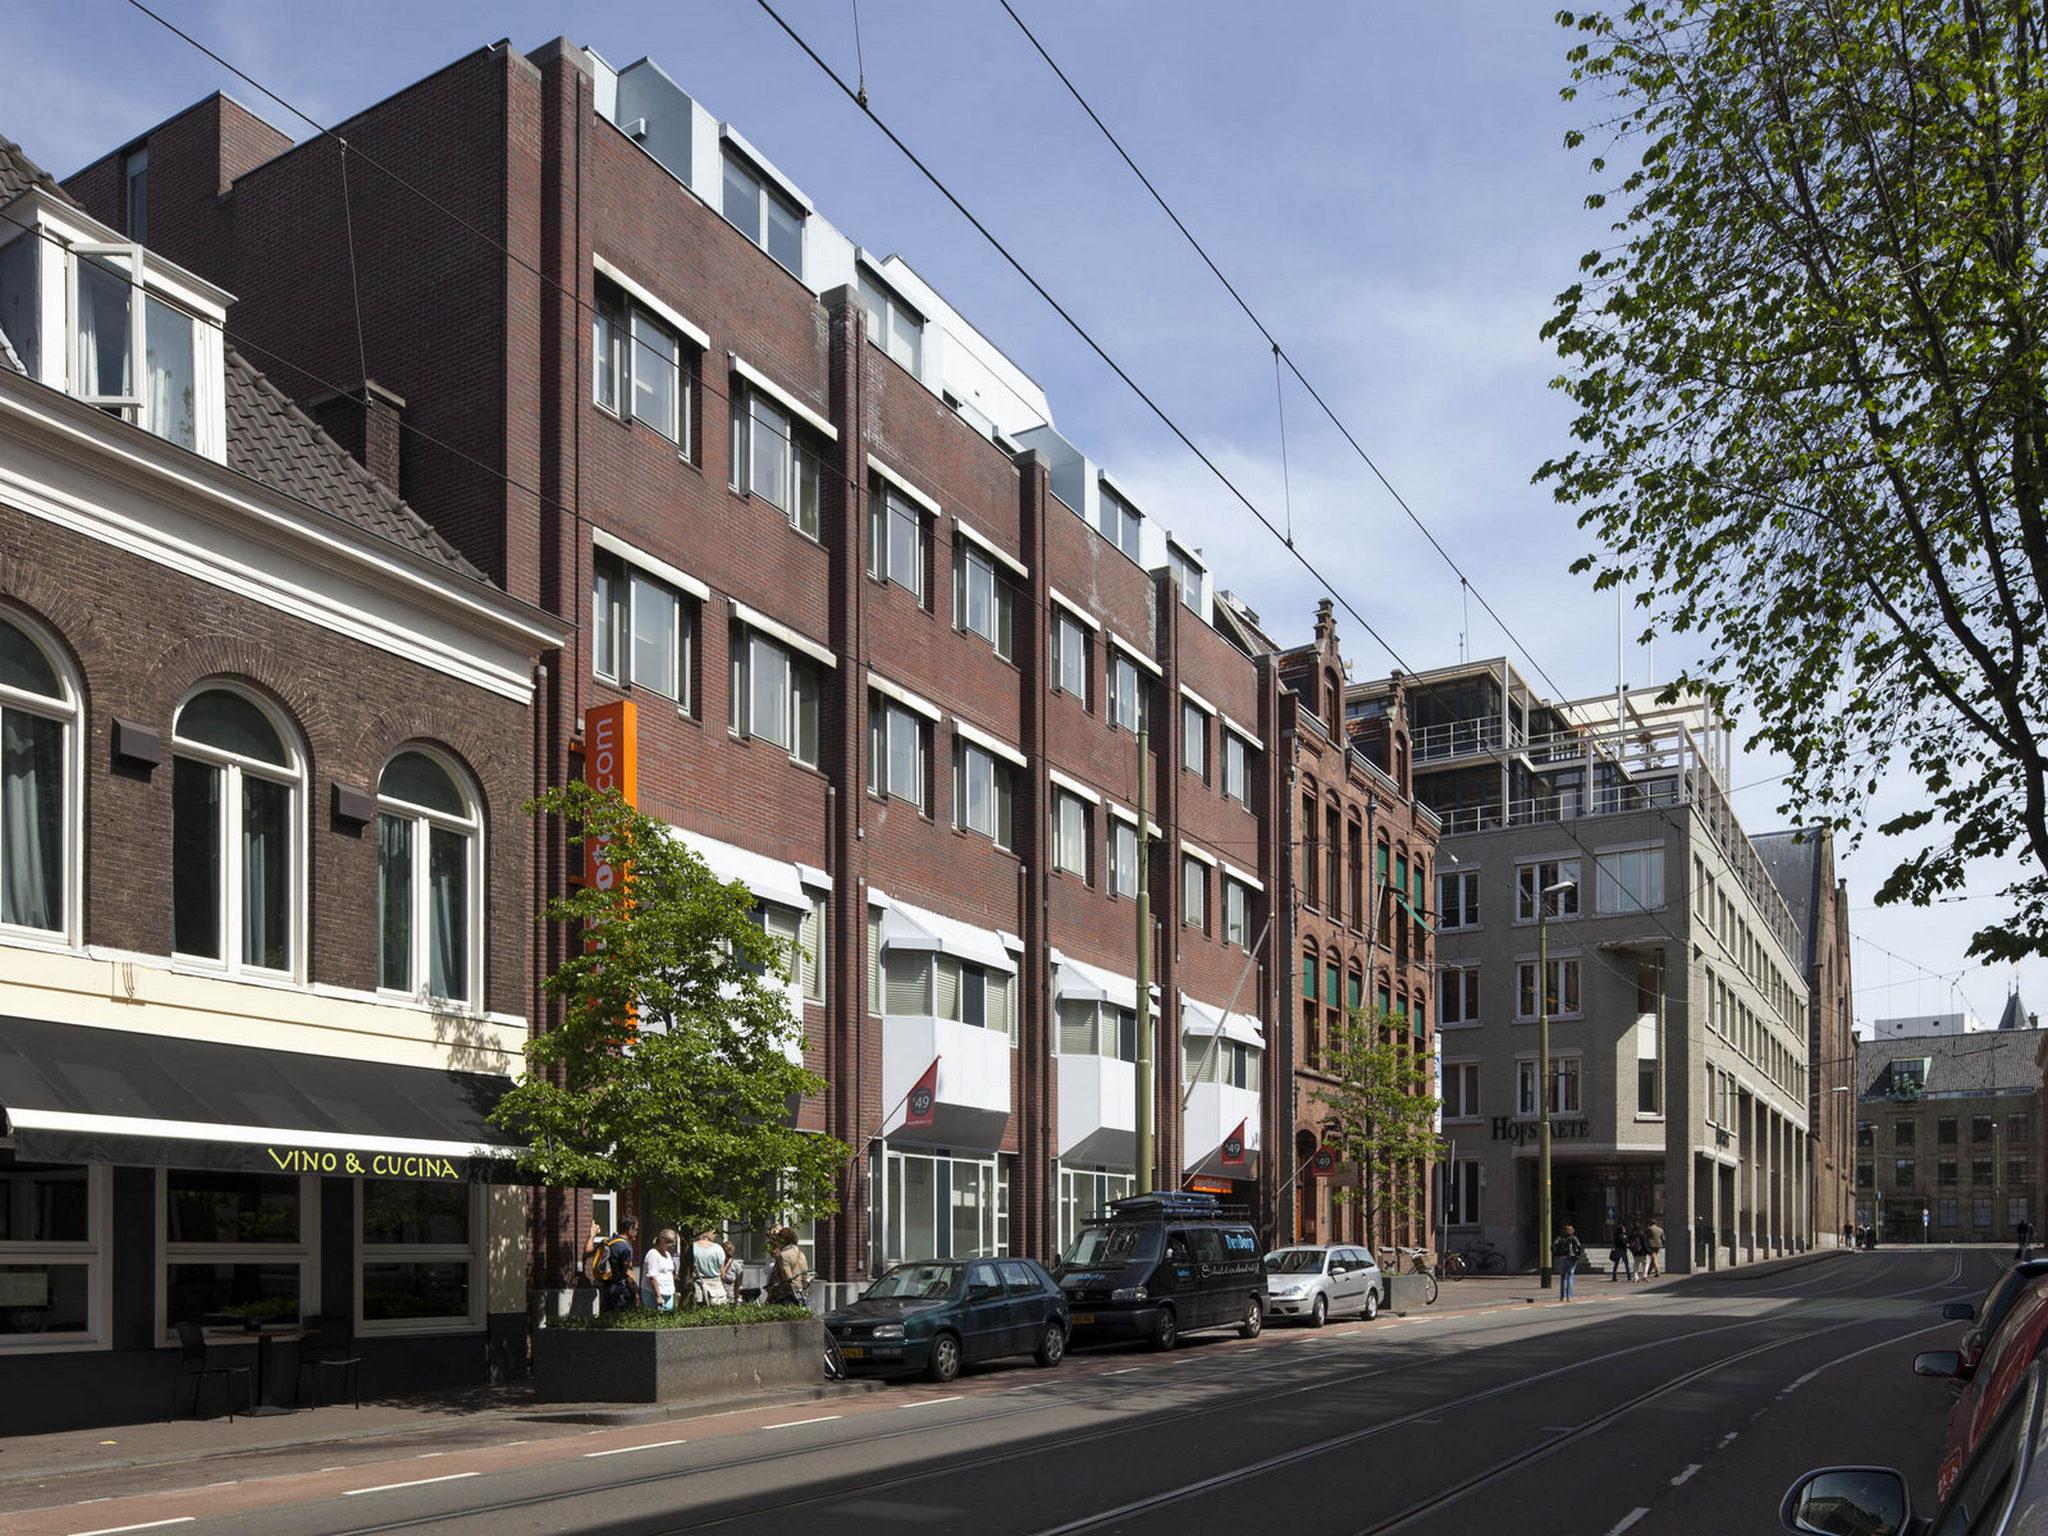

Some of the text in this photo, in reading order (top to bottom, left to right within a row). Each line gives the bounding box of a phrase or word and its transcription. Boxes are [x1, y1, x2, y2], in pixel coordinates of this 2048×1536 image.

[1491, 1116, 1590, 1146] HOFSAETE
[268, 1148, 459, 1180] VINO & CUCINA
